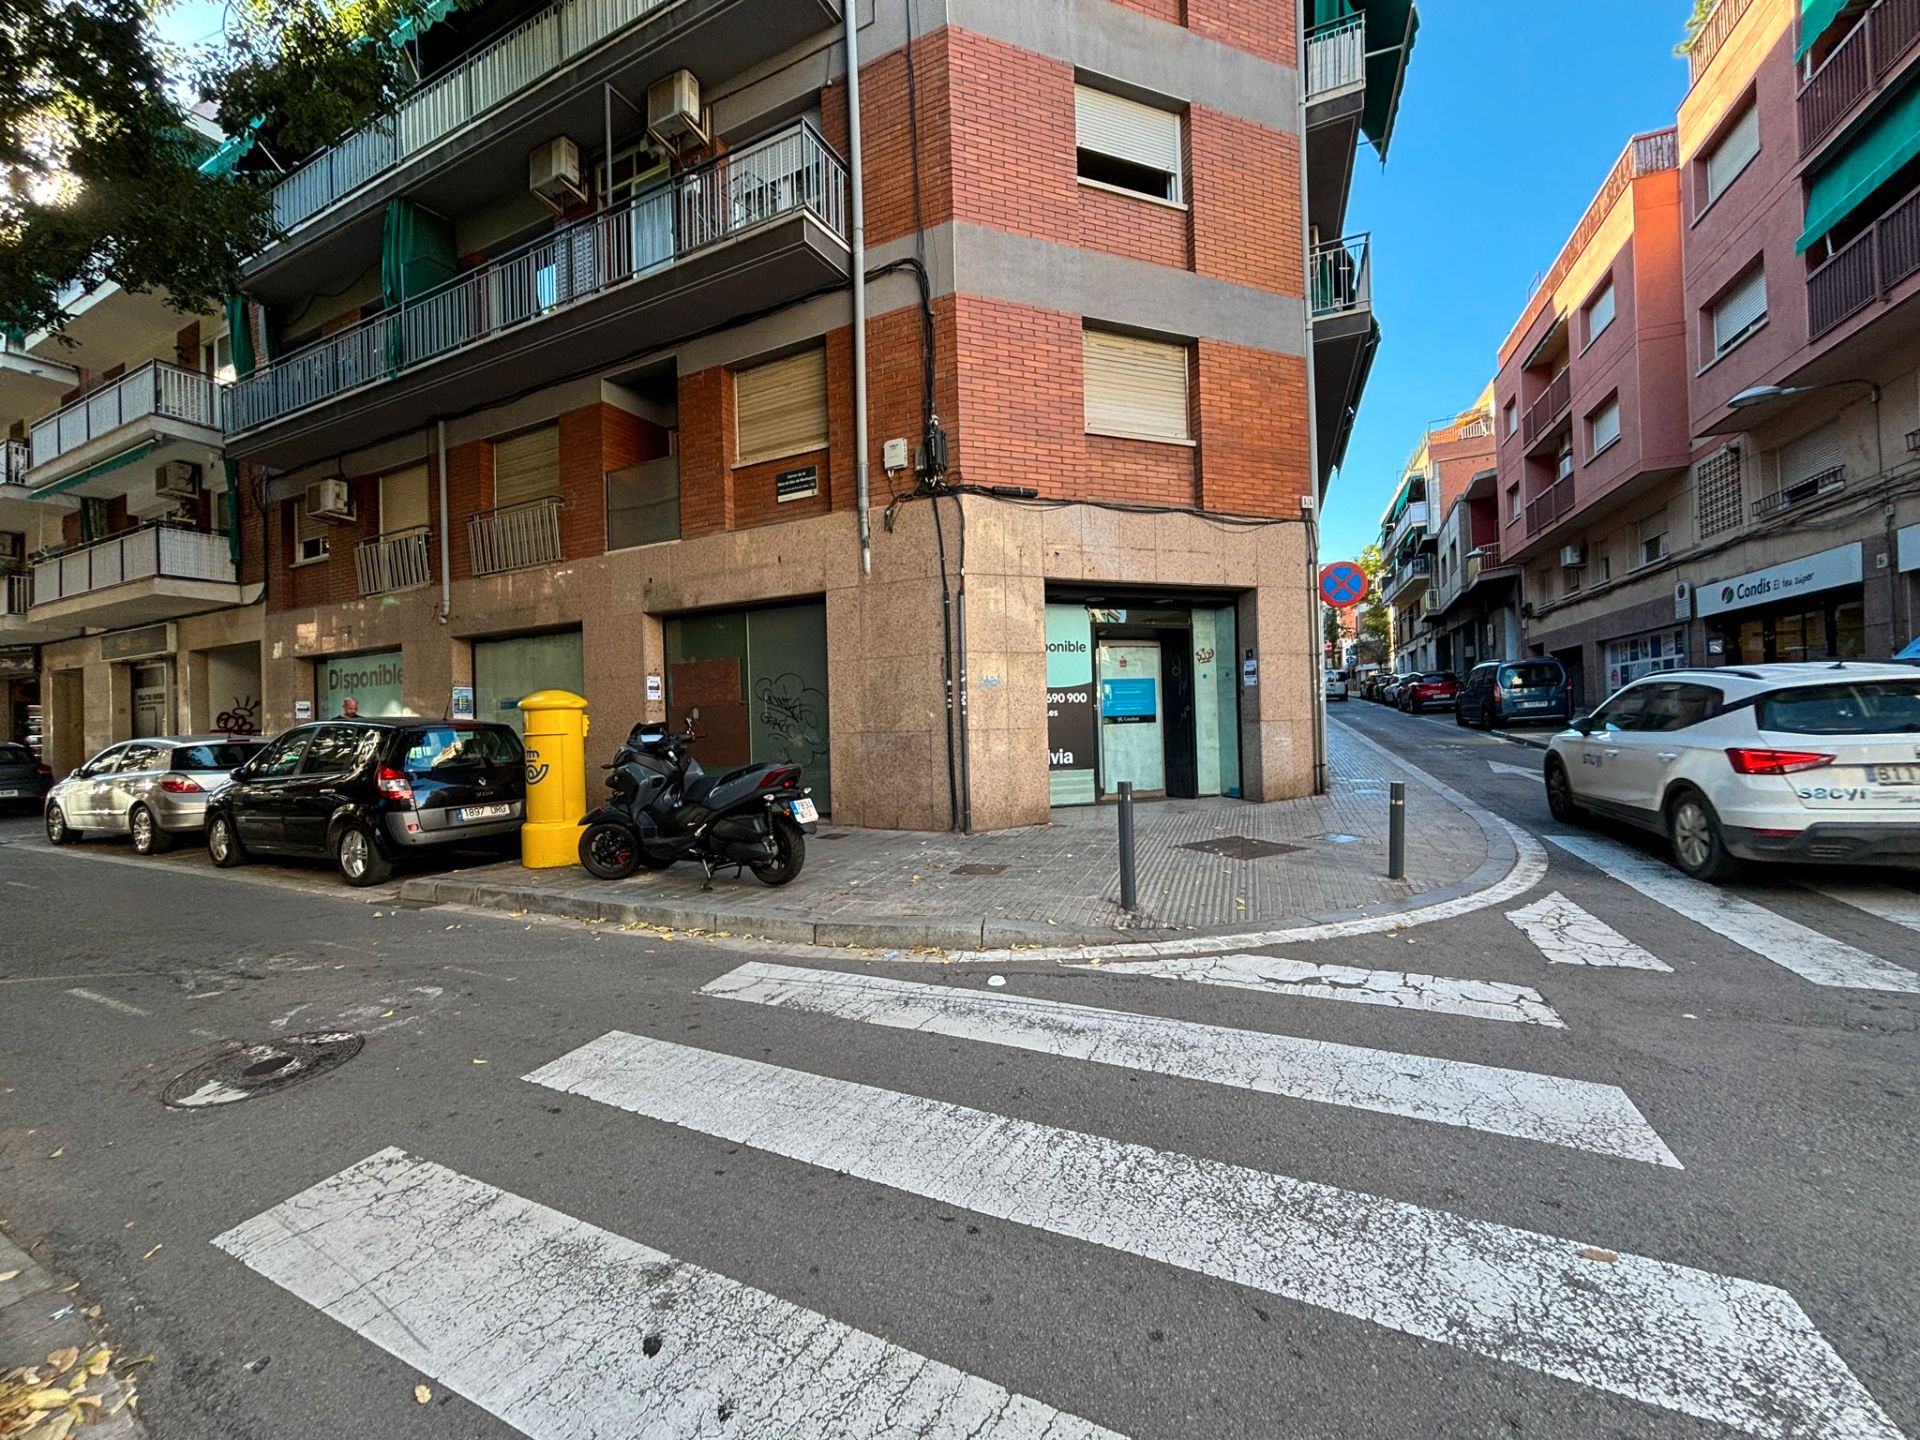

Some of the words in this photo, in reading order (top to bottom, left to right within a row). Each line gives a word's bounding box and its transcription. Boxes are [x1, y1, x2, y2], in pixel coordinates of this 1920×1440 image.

[1737, 578, 1771, 600] Condis
[1782, 577, 1793, 588] teu
[329, 663, 403, 694] Disponible
[1047, 692, 1065, 704] 690
[1067, 692, 1087, 704] 900
[1797, 787, 1871, 801] sacyr
[464, 806, 485, 817] 1897
